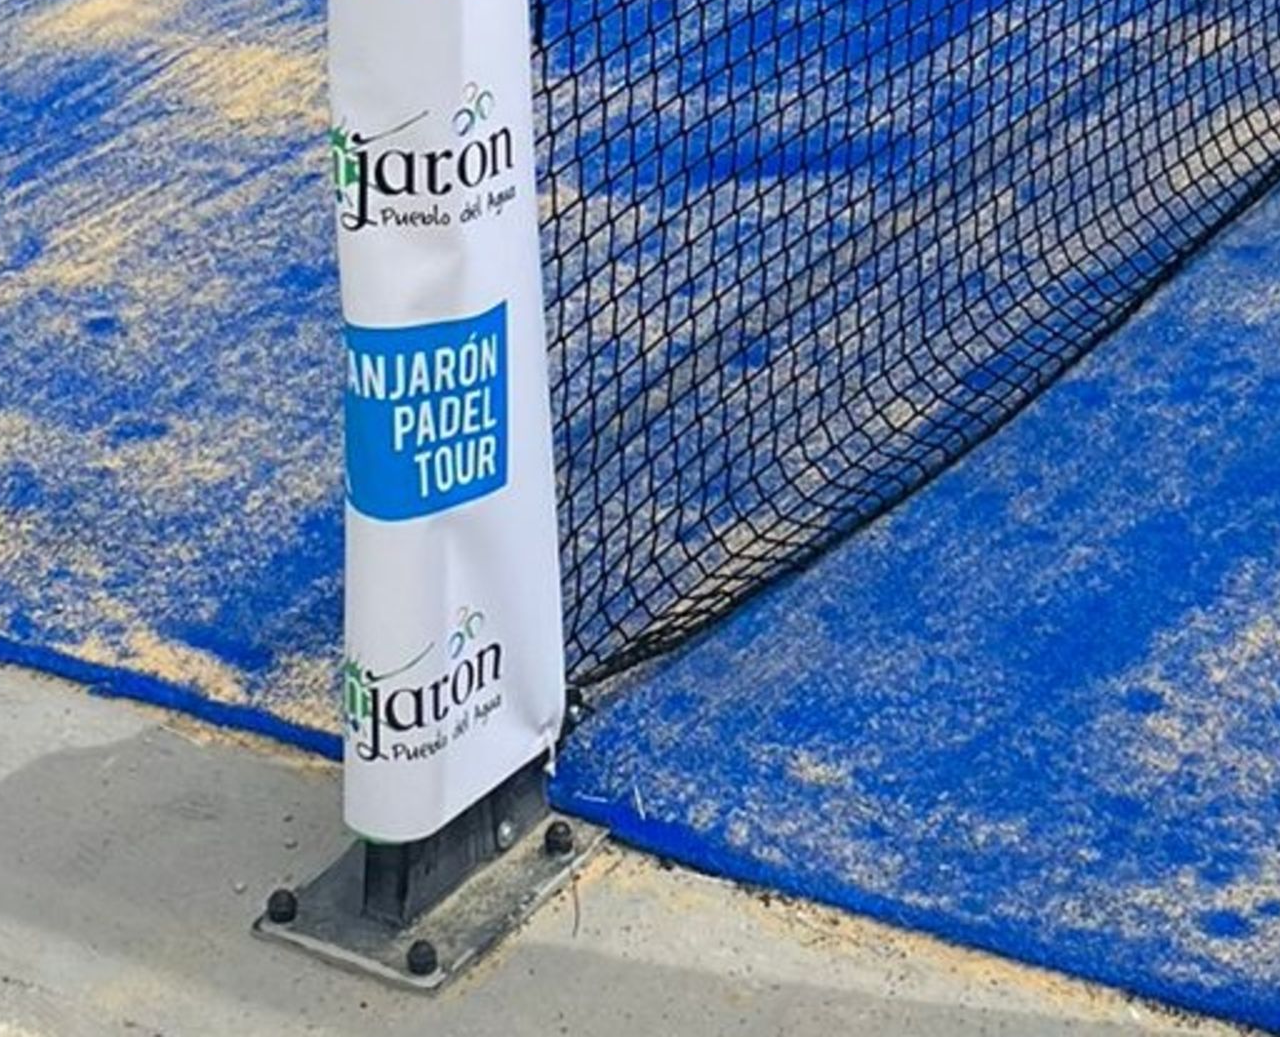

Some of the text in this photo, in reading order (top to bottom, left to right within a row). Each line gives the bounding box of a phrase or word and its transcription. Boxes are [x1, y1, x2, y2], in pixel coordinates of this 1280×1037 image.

[379, 204, 451, 228] Pueblo
[393, 386, 497, 452] PADEL
[414, 435, 496, 498] TOUR
